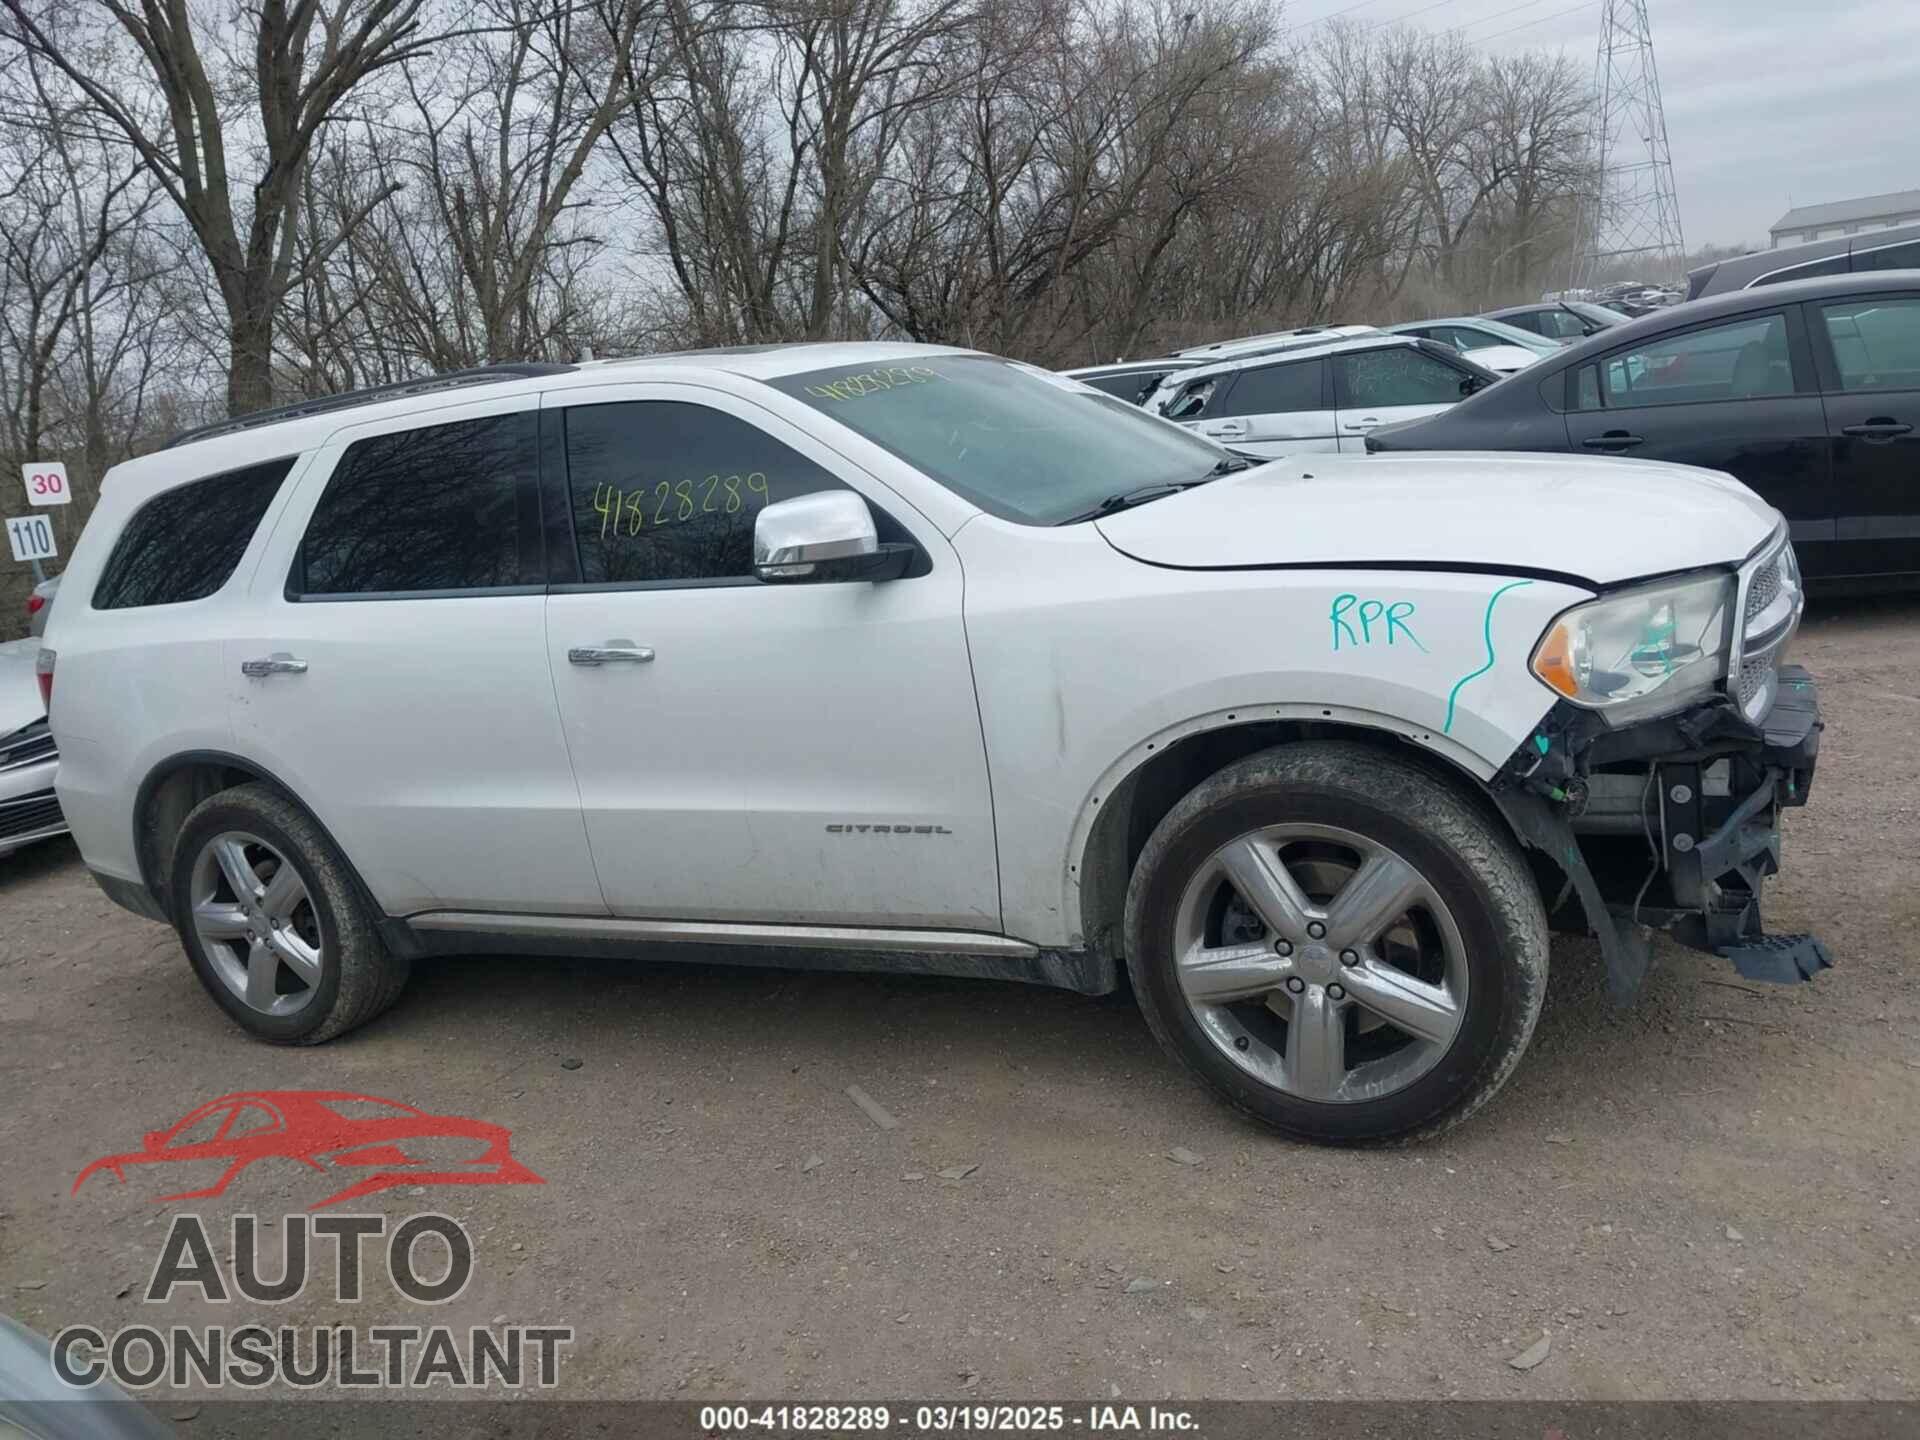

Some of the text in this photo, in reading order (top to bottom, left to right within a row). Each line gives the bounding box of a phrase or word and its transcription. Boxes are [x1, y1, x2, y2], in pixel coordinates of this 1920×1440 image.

[32, 473, 62, 495] 30
[593, 472, 769, 539] 41828289
[13, 519, 50, 556] 110
[1329, 593, 1430, 654] RPR
